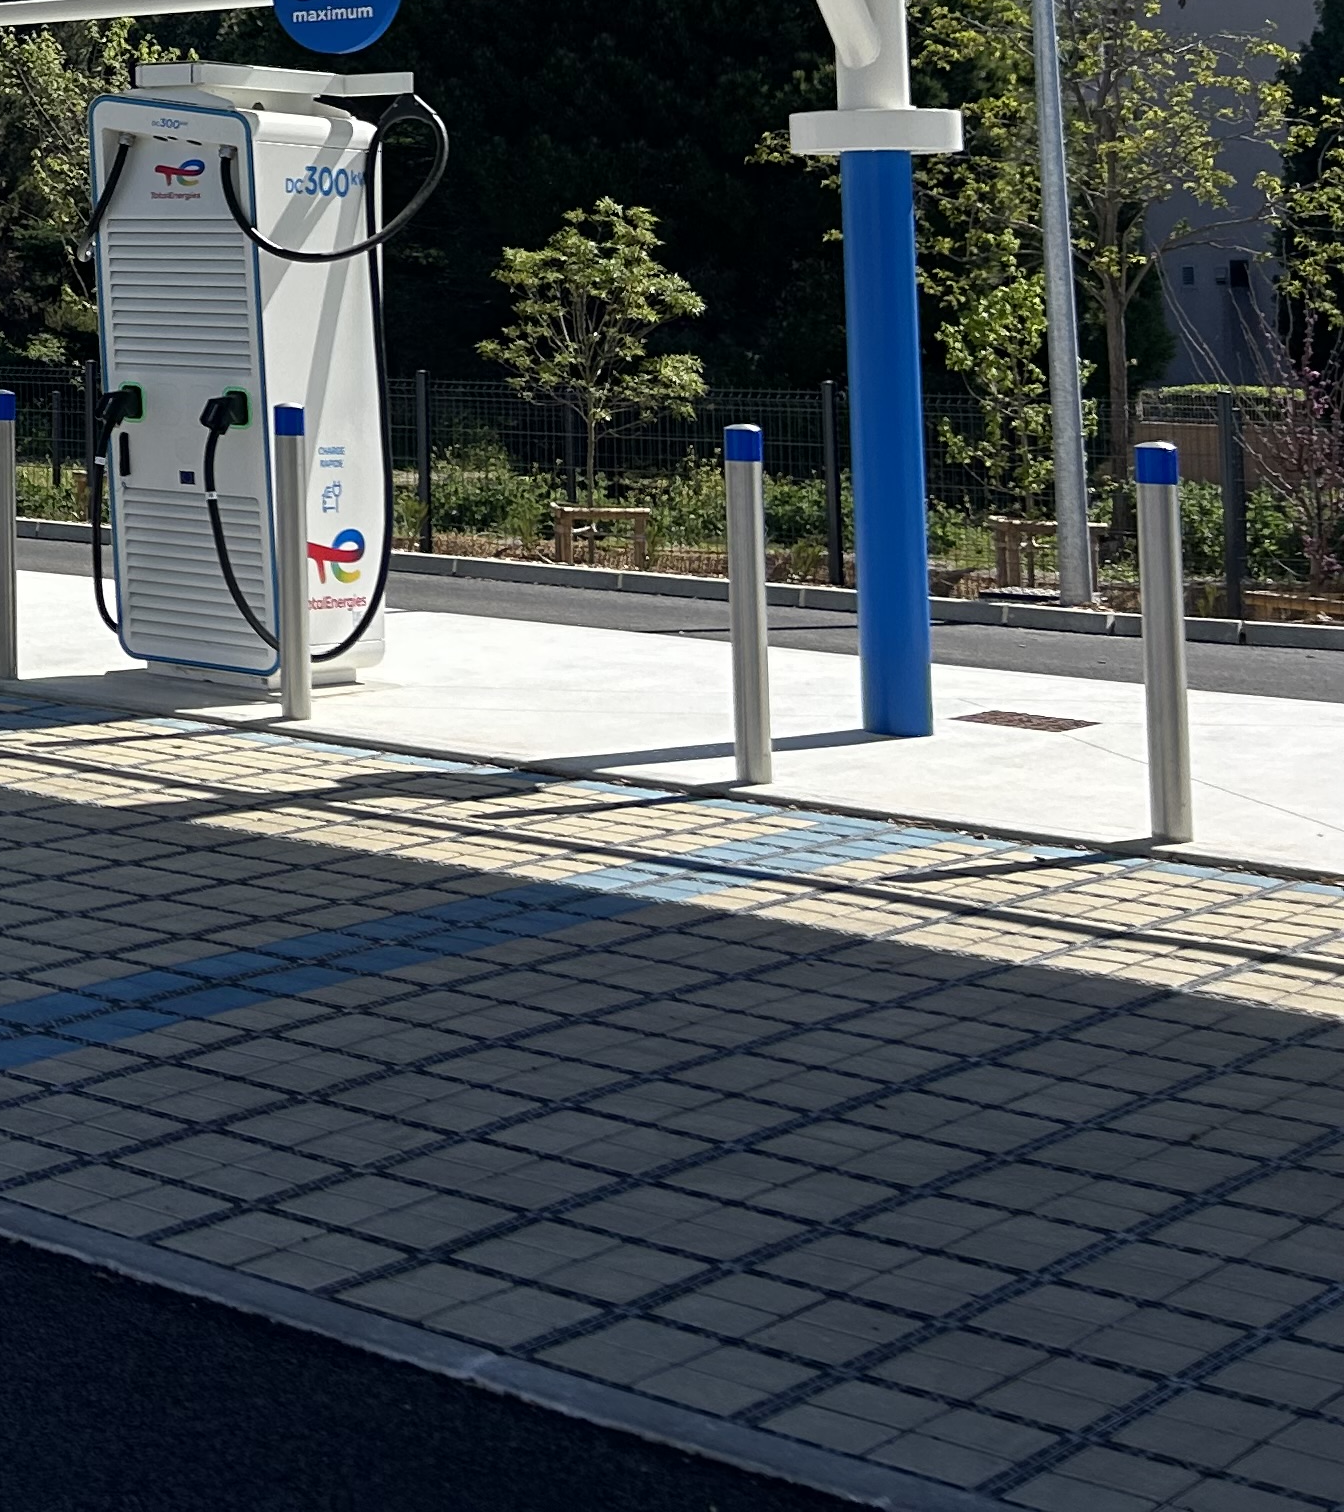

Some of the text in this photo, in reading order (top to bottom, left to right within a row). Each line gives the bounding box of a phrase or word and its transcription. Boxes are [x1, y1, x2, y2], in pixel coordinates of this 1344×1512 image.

[293, 6, 373, 23] maximum
[160, 118, 180, 129] 300
[285, 177, 304, 194] DC
[305, 165, 349, 197] 300
[308, 595, 367, 612] otalEnergies
